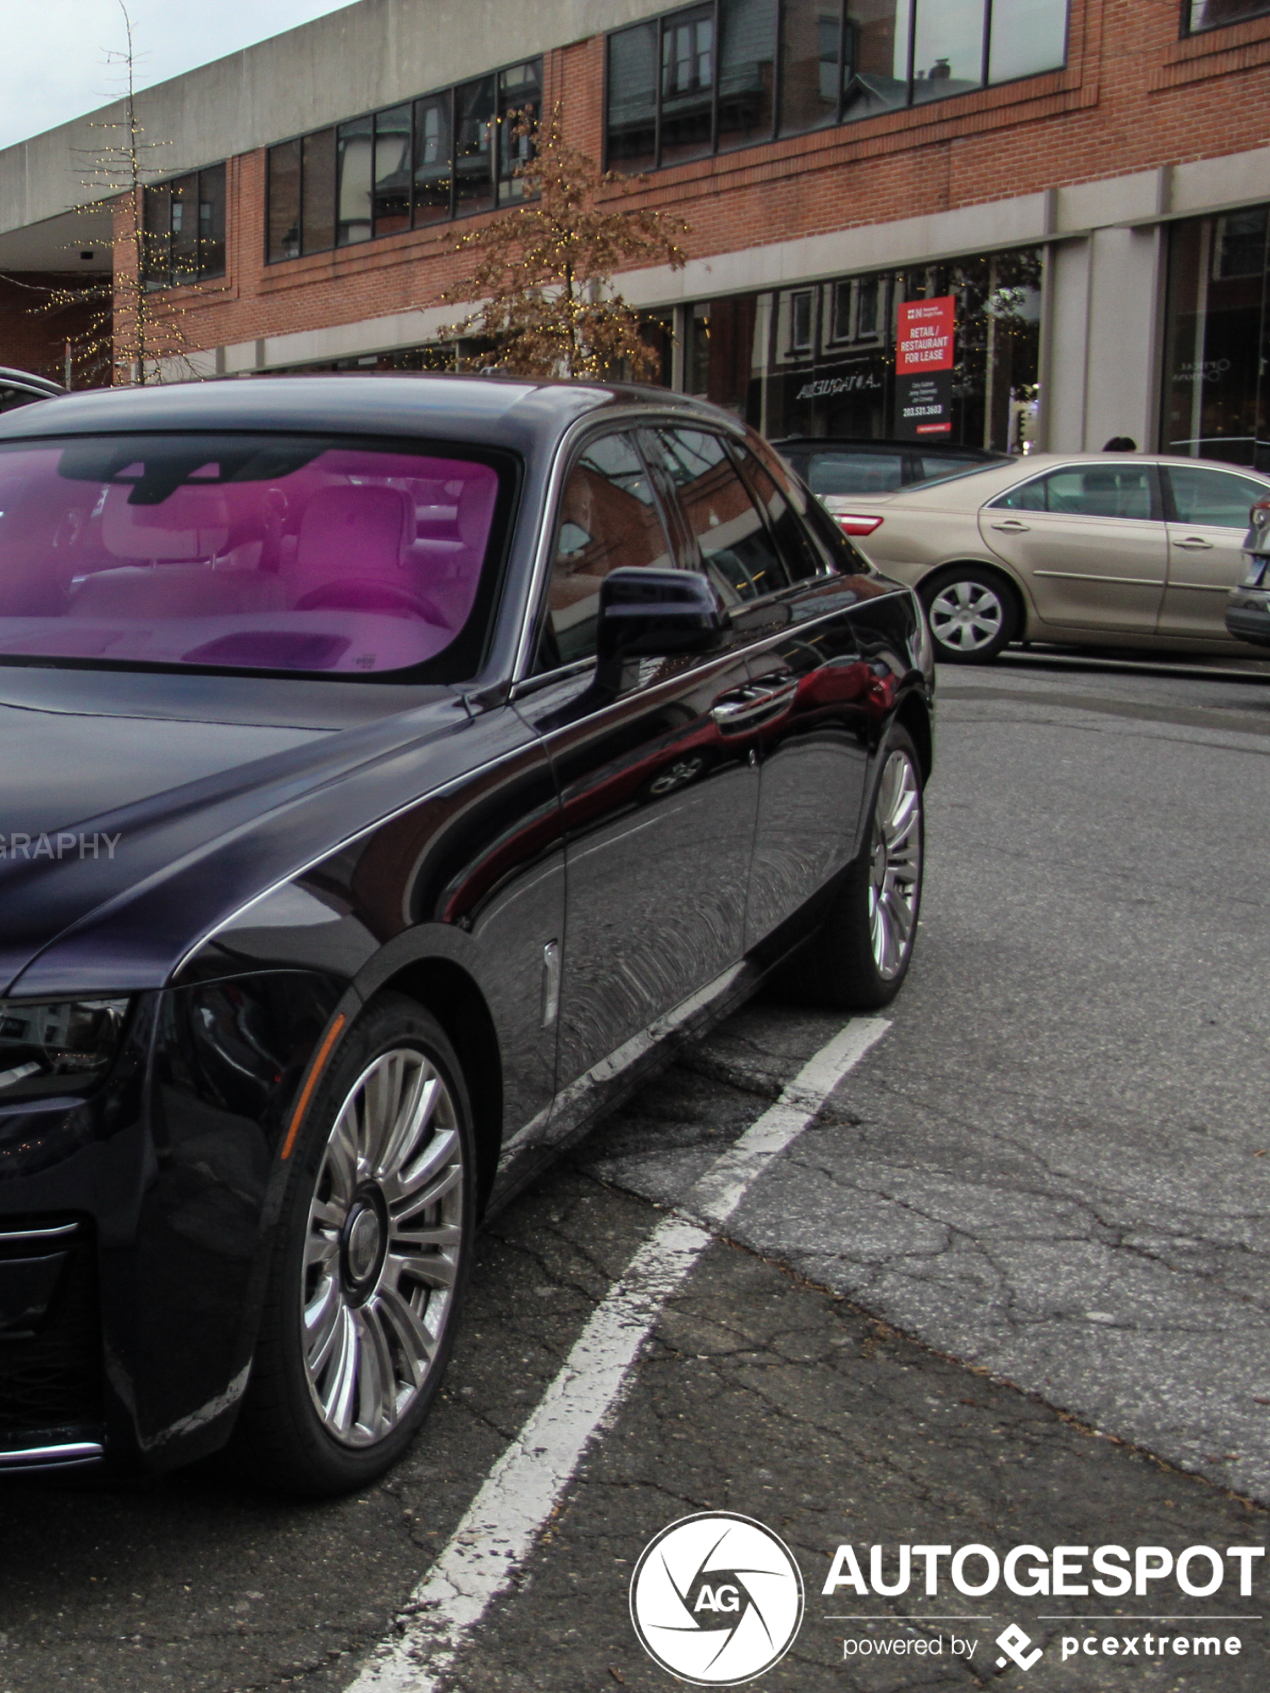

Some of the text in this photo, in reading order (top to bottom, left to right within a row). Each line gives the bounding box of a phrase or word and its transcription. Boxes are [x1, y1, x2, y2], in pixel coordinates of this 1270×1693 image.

[910, 327, 934, 338] RETAIL
[901, 337, 947, 351] RESTAURANT
[905, 350, 942, 363] FOR LEASE
